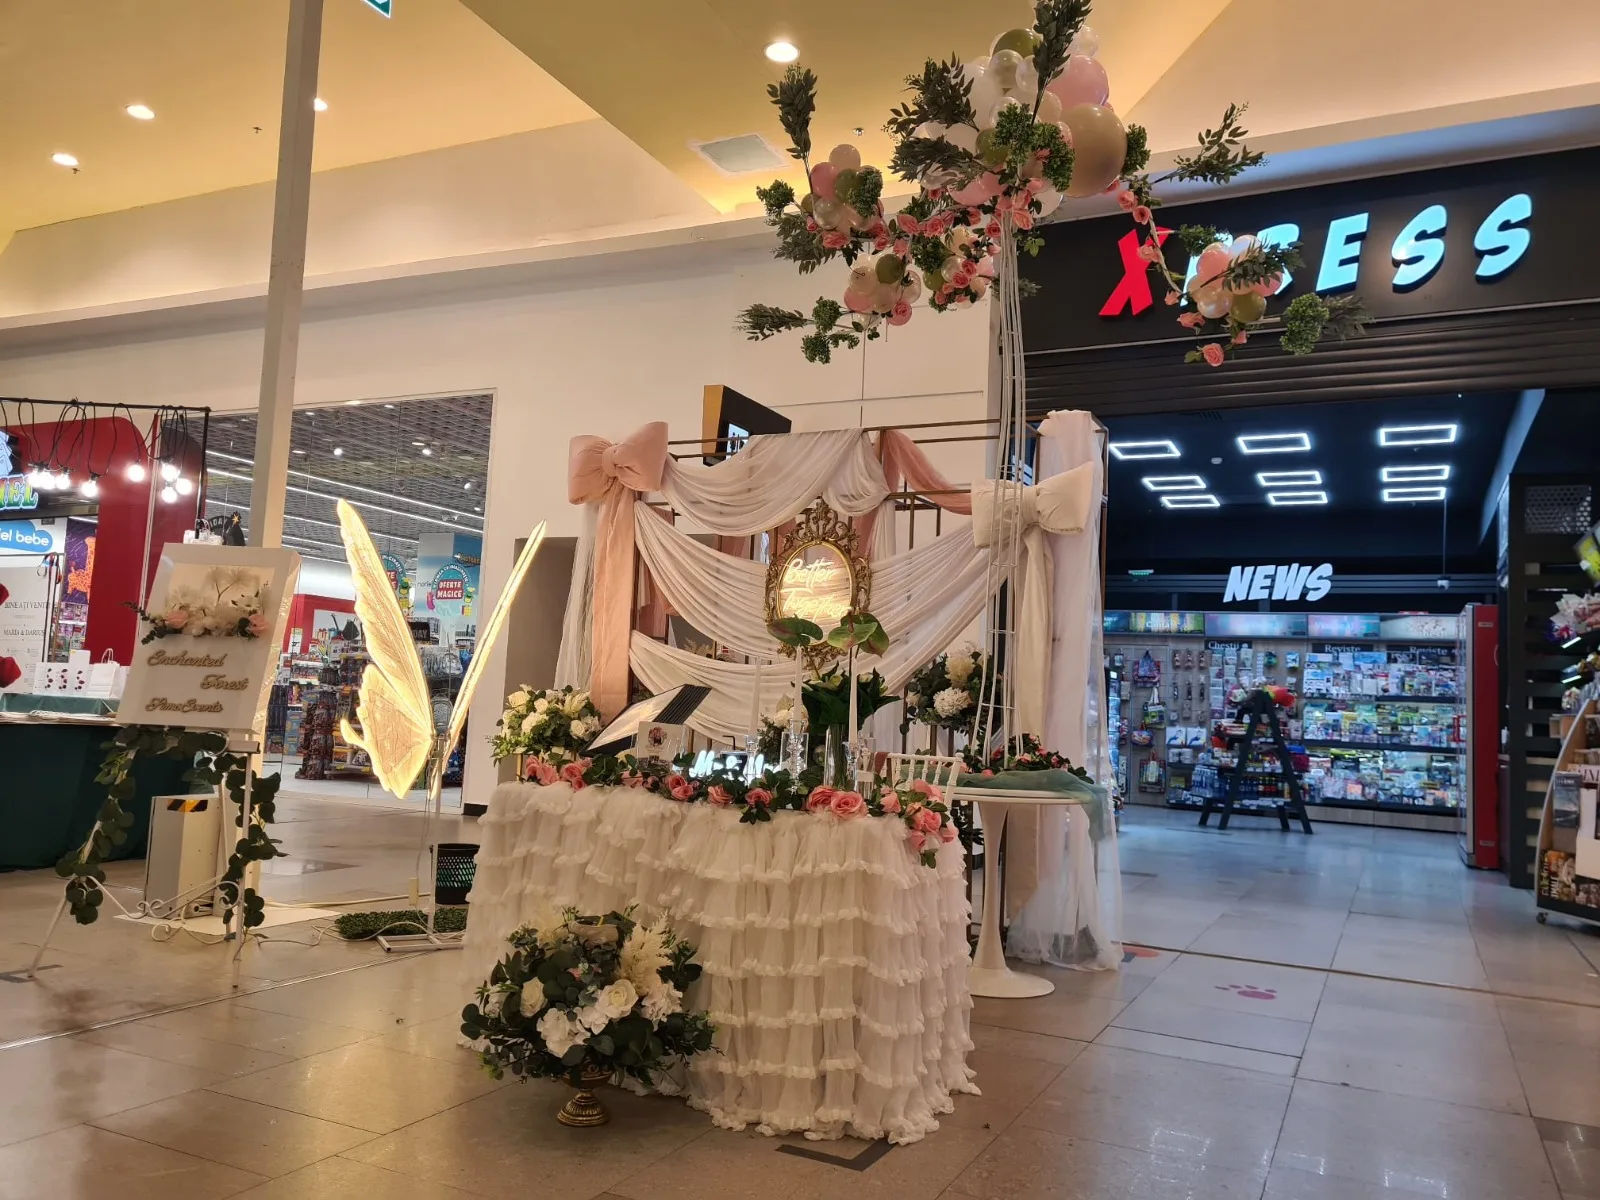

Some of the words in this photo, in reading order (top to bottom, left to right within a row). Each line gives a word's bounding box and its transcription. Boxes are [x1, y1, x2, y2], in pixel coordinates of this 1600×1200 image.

[1098, 193, 1532, 316] XESS
[15, 529, 50, 547] bebe
[783, 557, 840, 589] Better
[438, 581, 463, 589] OFERTE
[1222, 562, 1334, 604] NEWS
[436, 590, 463, 598] MAGICE
[780, 587, 852, 622] Together
[1325, 643, 1361, 654] Reviste
[147, 649, 228, 667] Enchanted
[200, 674, 249, 690] Forest
